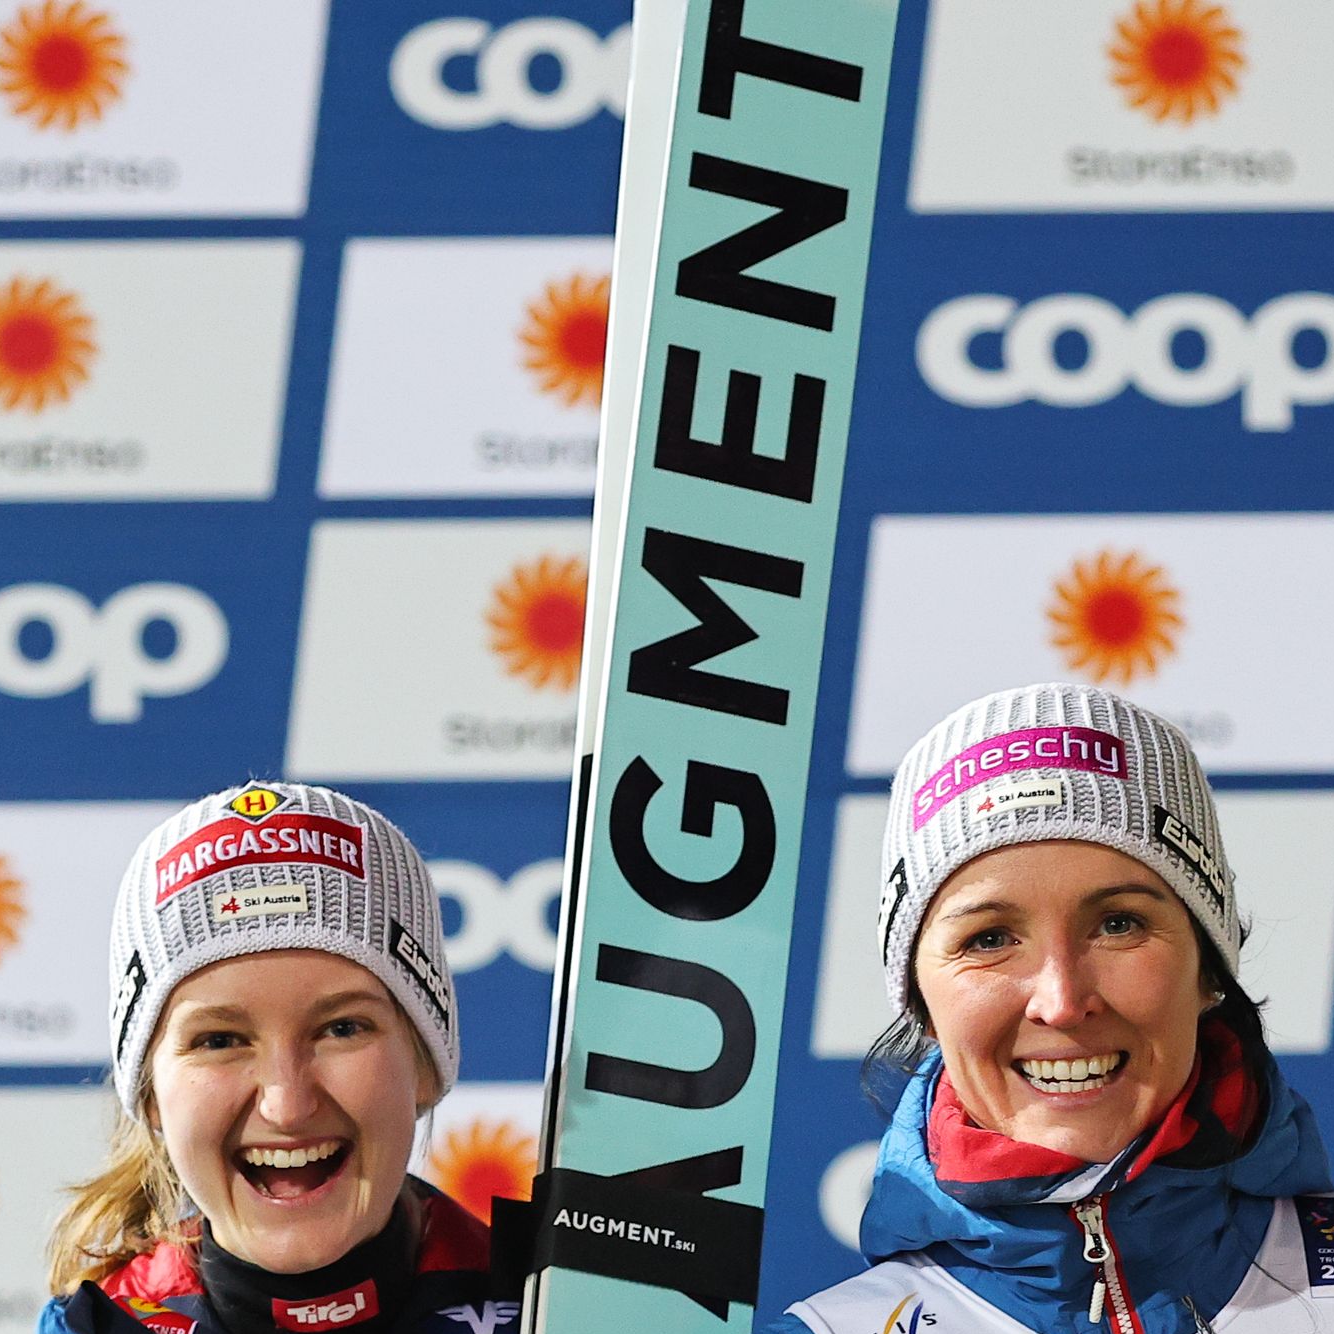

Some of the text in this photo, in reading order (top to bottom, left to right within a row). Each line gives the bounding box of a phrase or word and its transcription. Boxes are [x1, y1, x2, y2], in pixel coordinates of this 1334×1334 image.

[582, 0, 865, 1320] UGMENT
[916, 730, 1120, 816] scheschy
[998, 787, 1056, 804] Ski Austria
[158, 827, 361, 895] HARGASSNER
[244, 893, 302, 908] Ski Austria
[553, 1208, 696, 1254] AUGMENT.SKI
[286, 1292, 366, 1325] Tirol
